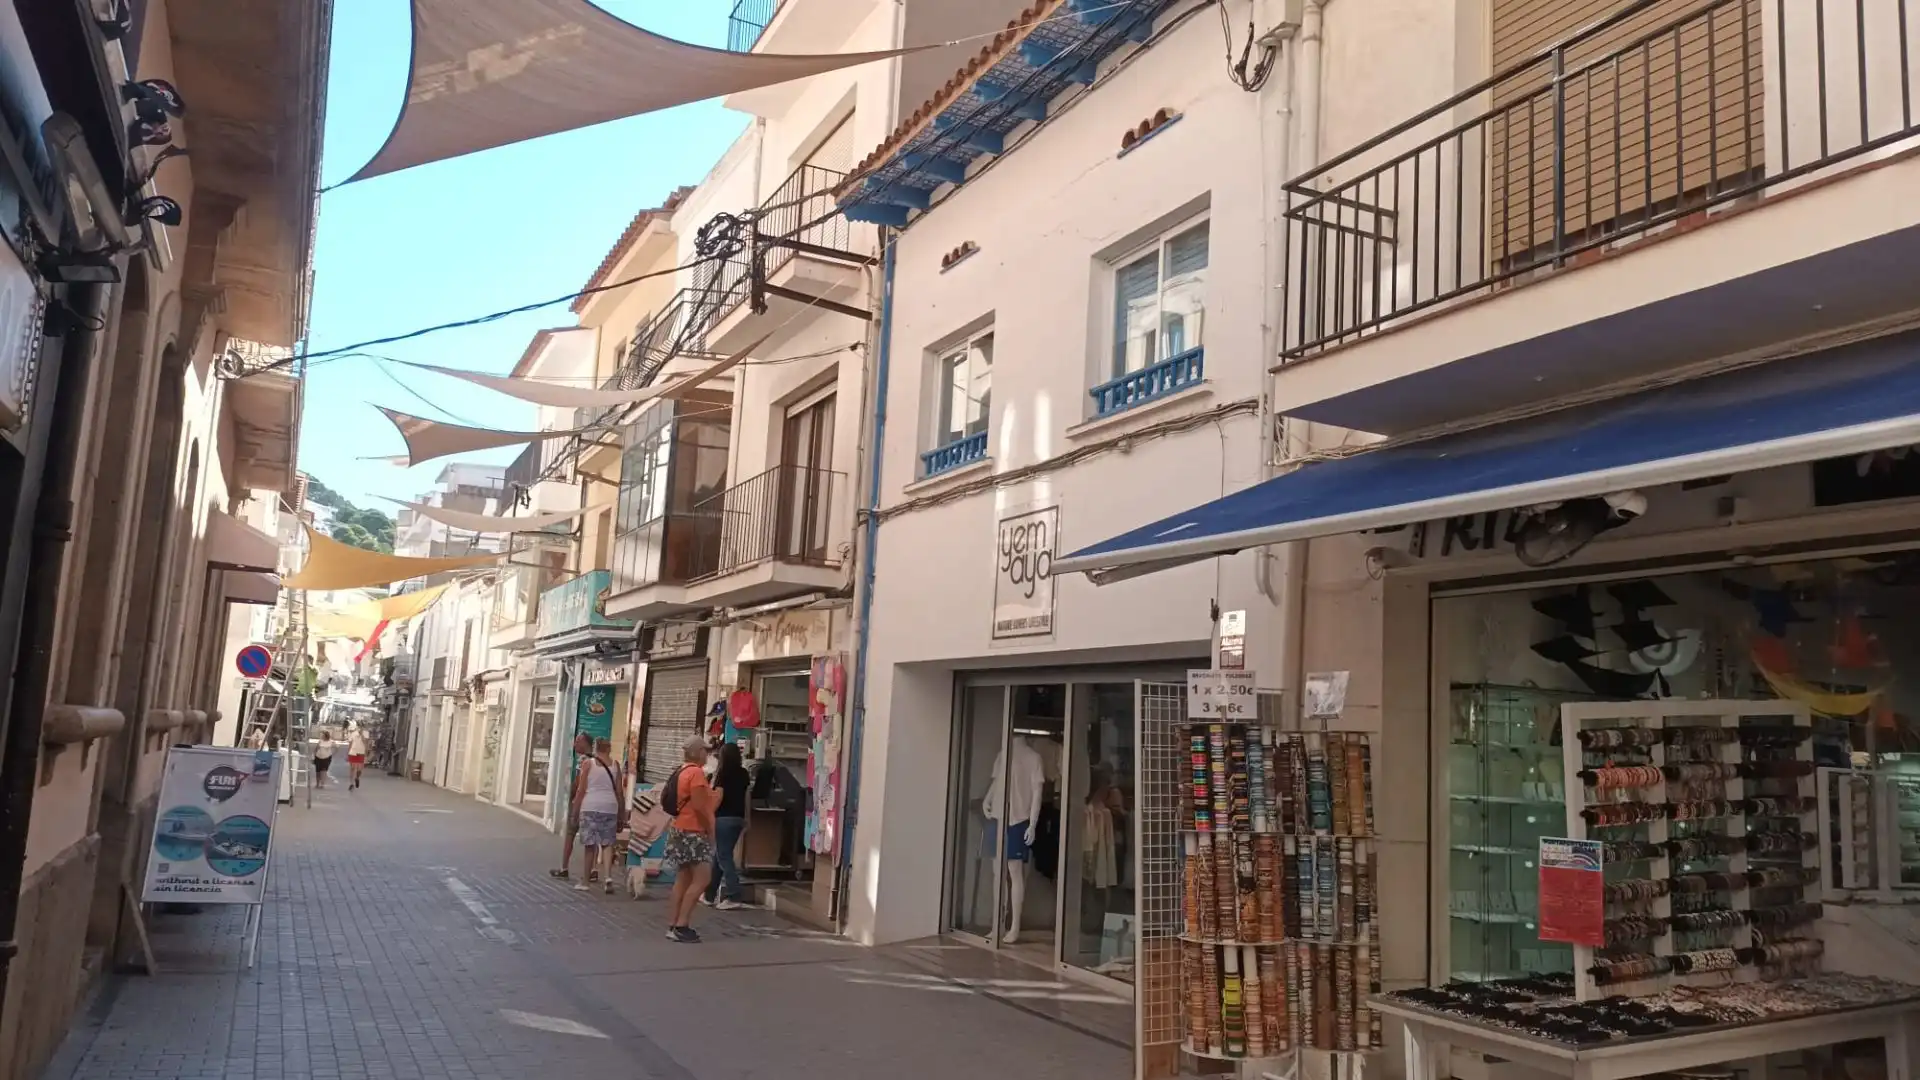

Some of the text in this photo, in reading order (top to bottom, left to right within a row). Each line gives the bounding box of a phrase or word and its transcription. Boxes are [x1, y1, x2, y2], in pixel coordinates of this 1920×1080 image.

[1001, 520, 1046, 572] yem
[1010, 549, 1052, 599] aya
[1192, 684, 1198, 694] 1
[1204, 686, 1213, 695] x
[1202, 702, 1211, 713] 3
[155, 876, 199, 885] without
[153, 884, 172, 892] sin
